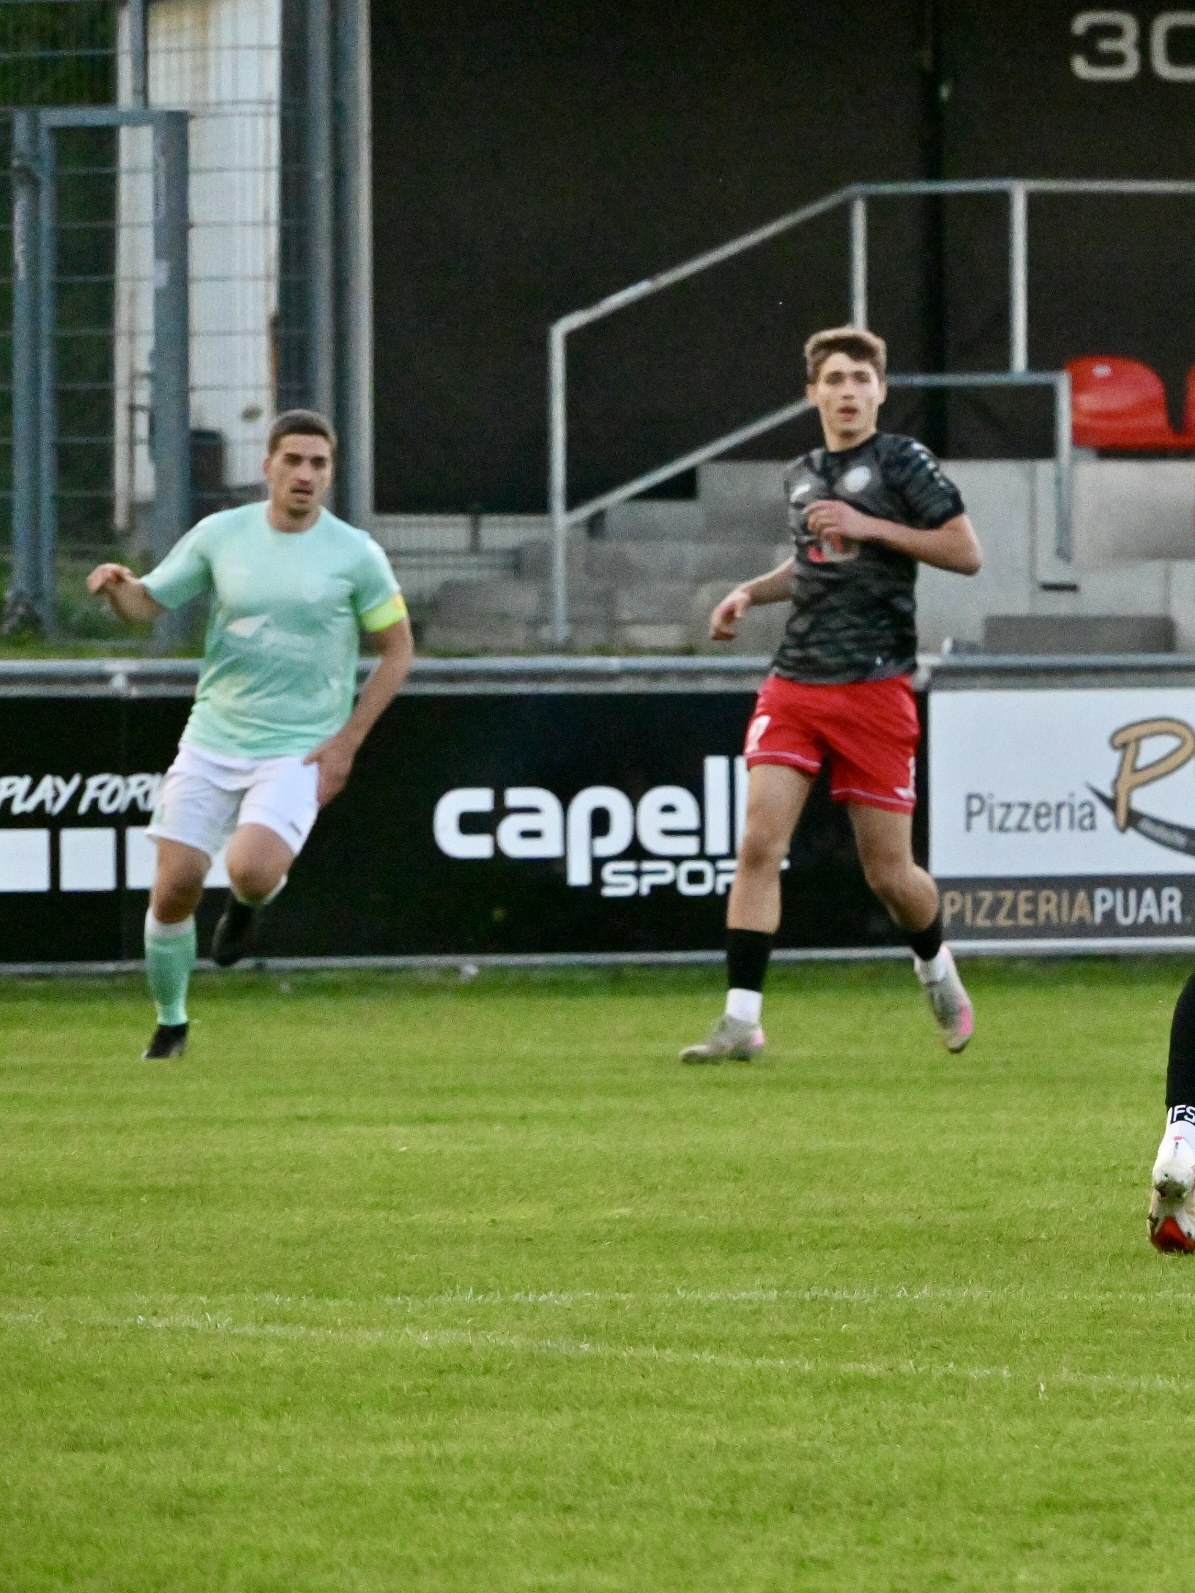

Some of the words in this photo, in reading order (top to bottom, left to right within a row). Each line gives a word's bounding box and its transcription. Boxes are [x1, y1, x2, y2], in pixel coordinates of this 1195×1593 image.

[0, 772, 82, 816] PLAY
[965, 792, 1097, 833] Pizzeria
[433, 754, 748, 886] capel
[600, 860, 790, 897] SPO
